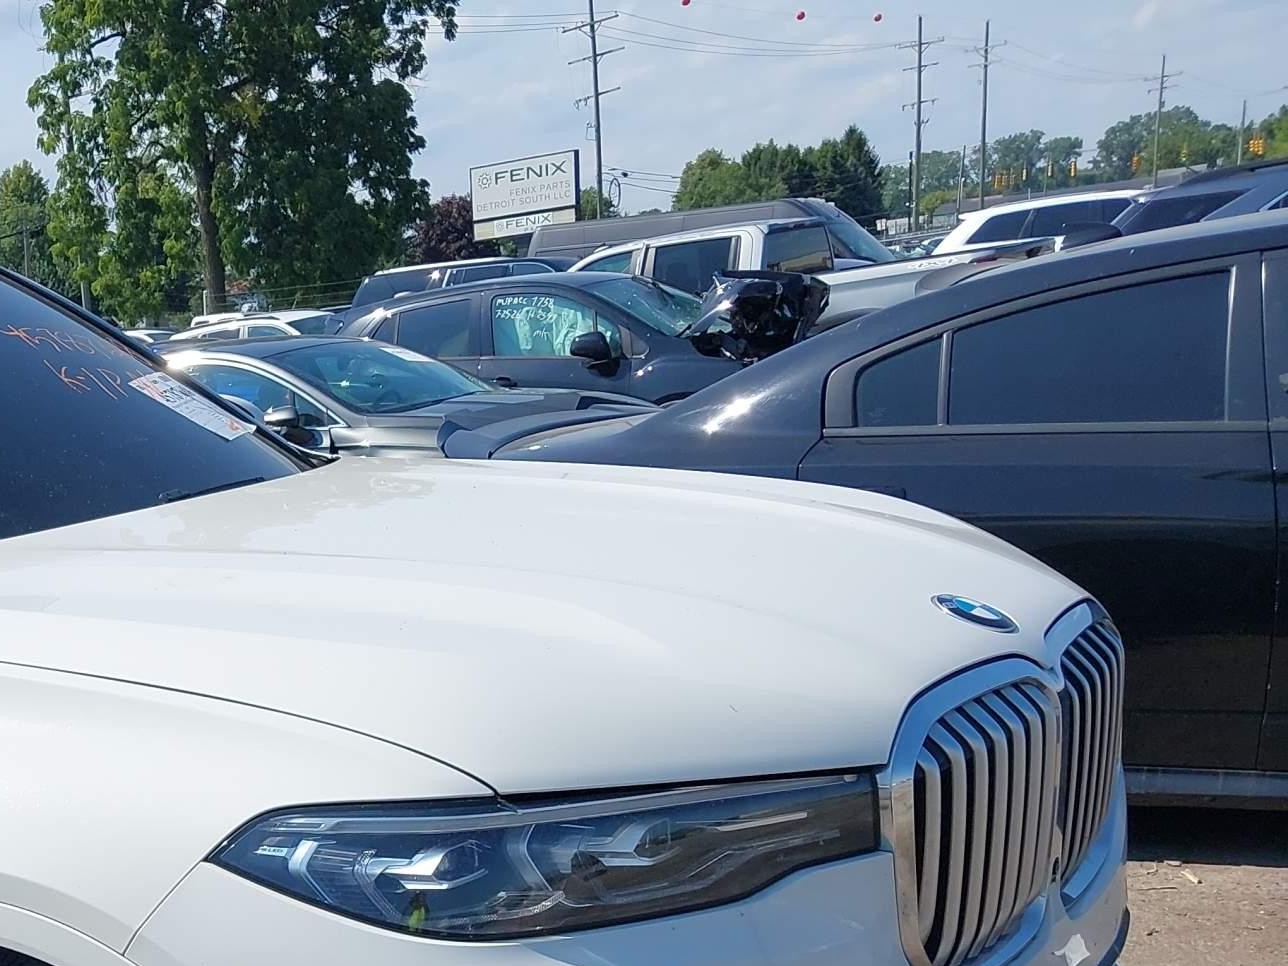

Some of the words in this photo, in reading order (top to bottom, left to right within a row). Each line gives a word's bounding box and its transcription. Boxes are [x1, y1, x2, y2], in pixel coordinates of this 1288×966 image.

[494, 160, 567, 185] FENIX
[509, 185, 536, 197] FENIX
[540, 180, 570, 191] PARTS
[476, 198, 516, 213] DETROIT
[519, 194, 551, 206] SOUTH
[553, 190, 571, 200] LLC
[505, 214, 552, 229] FENIX
